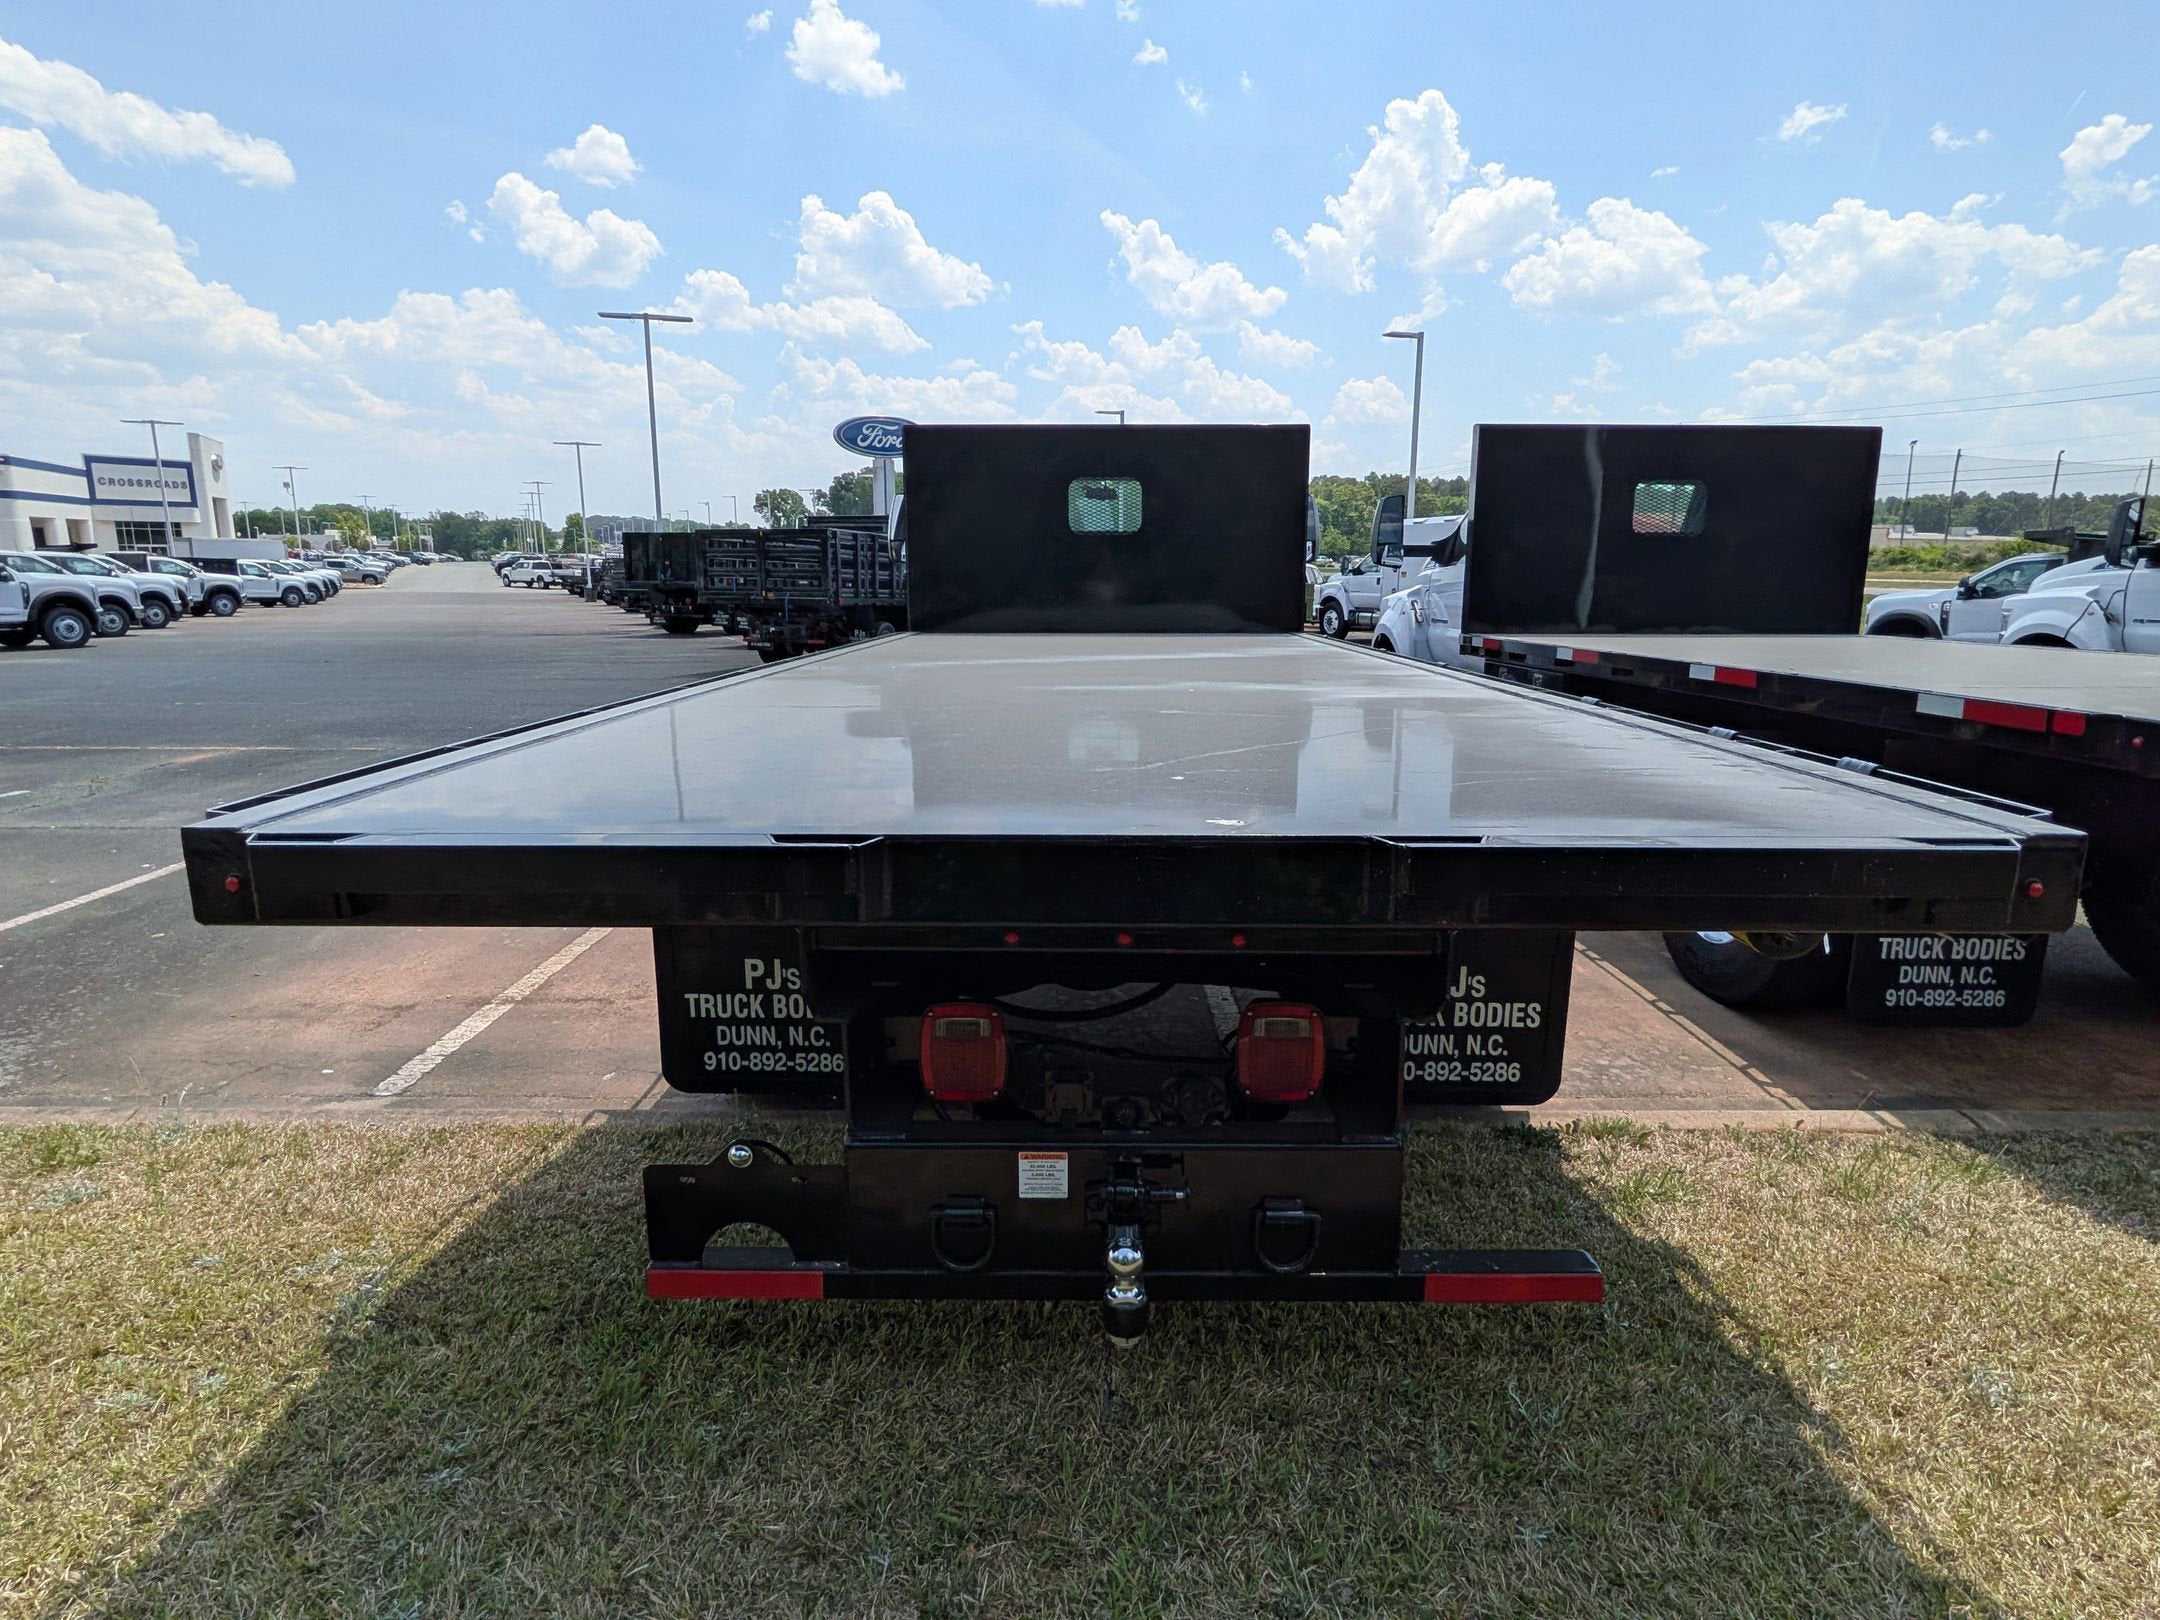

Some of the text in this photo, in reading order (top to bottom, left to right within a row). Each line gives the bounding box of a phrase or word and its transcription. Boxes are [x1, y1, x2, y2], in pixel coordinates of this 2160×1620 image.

[97, 476, 188, 490] CROSSROADS
[1879, 937, 2027, 961] TRUCK BODIES
[744, 958, 801, 990] PJ's
[1450, 965, 1486, 998] J's
[1899, 965, 1997, 987] DUNN, N.C.
[684, 993, 814, 1019] TRUCK BO
[1885, 988, 2006, 1008] 910-892-5286
[1453, 1001, 1542, 1028] BODIES
[716, 1025, 831, 1050] DUNN, N.C.
[1404, 1033, 1508, 1059] UNN, N.C.
[703, 1051, 844, 1073] 910-892-5286
[1403, 1060, 1521, 1083] 0-892-5286
